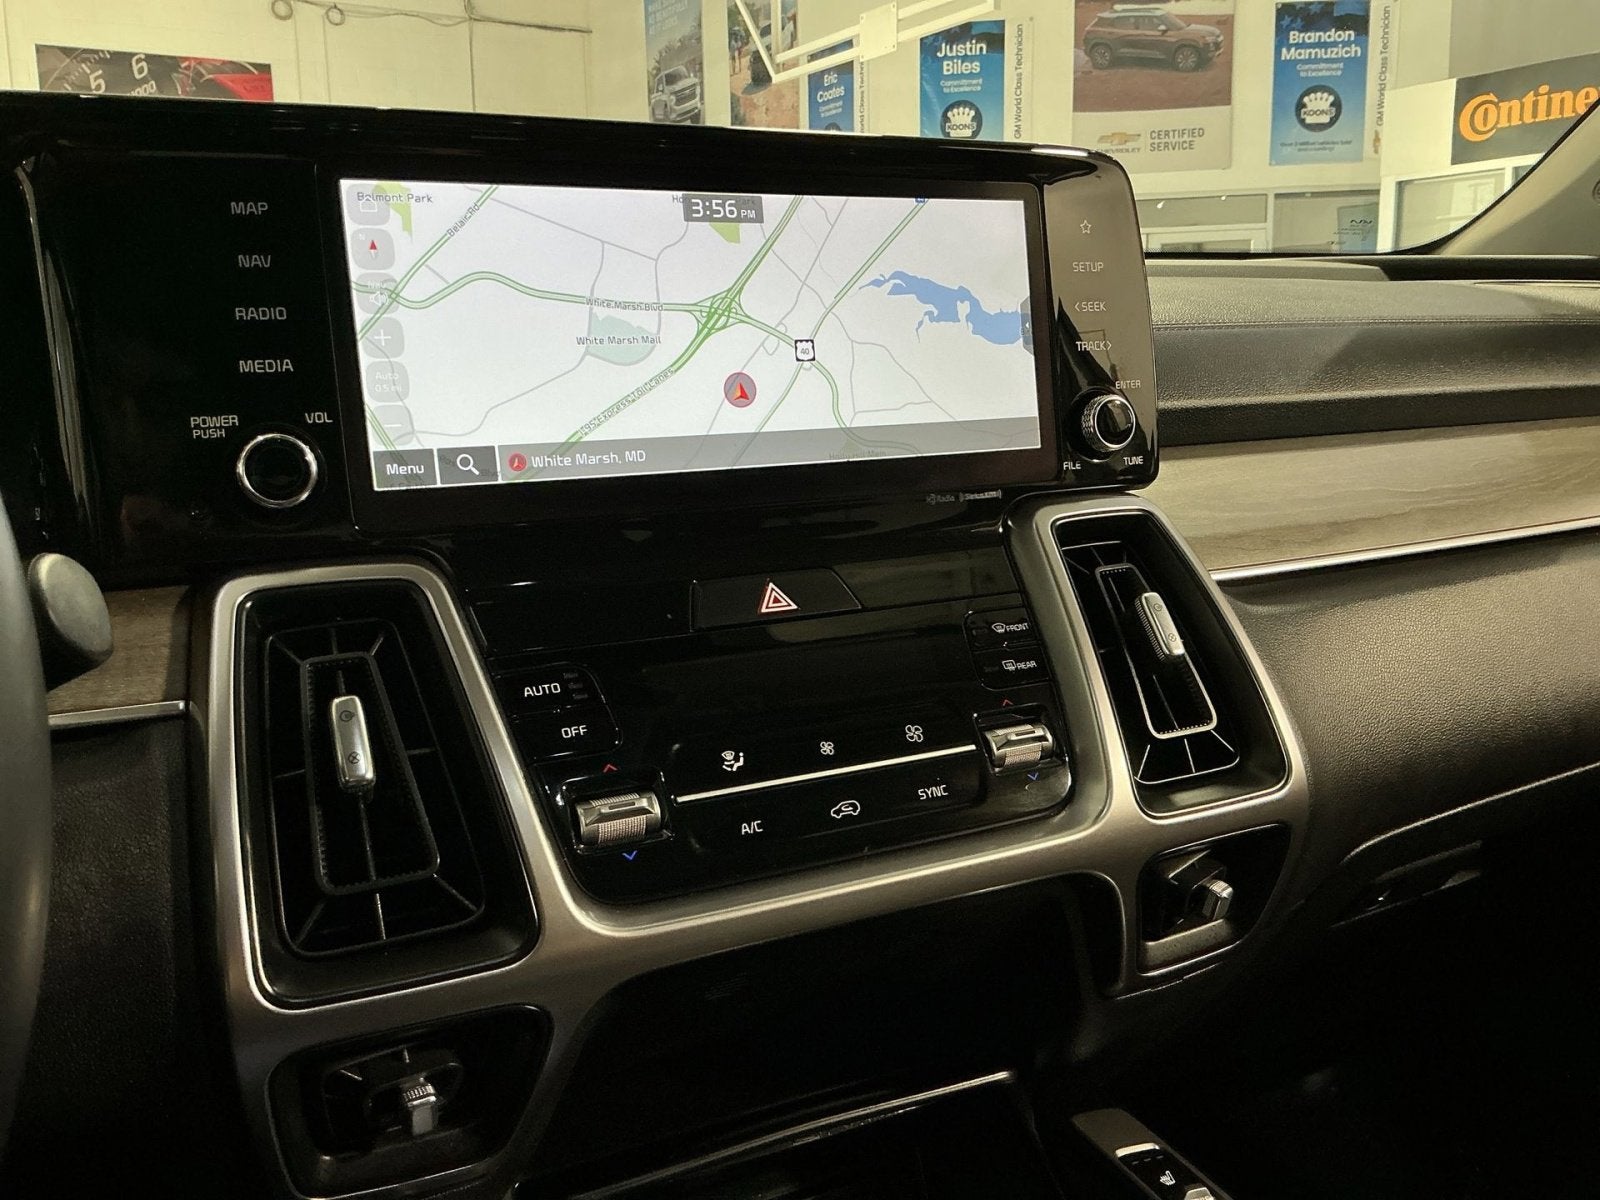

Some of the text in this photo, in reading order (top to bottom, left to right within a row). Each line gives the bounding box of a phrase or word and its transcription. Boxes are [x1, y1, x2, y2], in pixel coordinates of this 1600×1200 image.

[1289, 28, 1355, 44] Brandon
[937, 40, 987, 58] Justin
[1281, 44, 1361, 60] Mamuzich
[132, 53, 148, 80] 6
[943, 60, 981, 75] Biles
[1376, 5, 1391, 127] GM World Class Technician
[88, 70, 106, 93] 5
[823, 72, 838, 86] Eric
[1014, 24, 1023, 139] GM World Class Technician
[130, 80, 157, 95] 000
[817, 86, 845, 102] Coates
[1303, 109, 1335, 117] KOONS
[1459, 84, 1600, 142] Contine
[946, 122, 976, 131] KOONS
[1150, 128, 1205, 140] CERTIFIED
[1150, 140, 1195, 152] SERVICE
[407, 193, 433, 204] Park
[230, 201, 268, 215] MAP
[691, 198, 738, 218] 3:56
[740, 209, 756, 219] PM
[446, 215, 469, 237] Belair
[238, 254, 271, 268] NAV
[1072, 261, 1104, 272] SETUP
[585, 298, 664, 312] White Marsh Blvd
[1081, 301, 1106, 312] SEEK
[235, 307, 287, 320] RADIO
[576, 335, 661, 345] White Marsh Mall
[1076, 340, 1106, 351] TRACK
[239, 359, 294, 373] MEDIA
[1115, 379, 1141, 389] ENTER
[304, 411, 333, 424] VOL
[597, 397, 632, 424] Express
[190, 415, 239, 428] POWER
[193, 428, 226, 439] PUSH
[531, 450, 646, 468] White Marsh, MD
[1063, 461, 1081, 470] FILE
[1123, 455, 1144, 465] TUNE
[386, 463, 425, 475] Menu
[1006, 622, 1029, 632] FRONT
[1016, 660, 1037, 670] REAR
[524, 682, 561, 697] AUTO
[561, 725, 588, 738] OFF
[918, 784, 948, 800] SYNC
[741, 820, 763, 835] A/C
